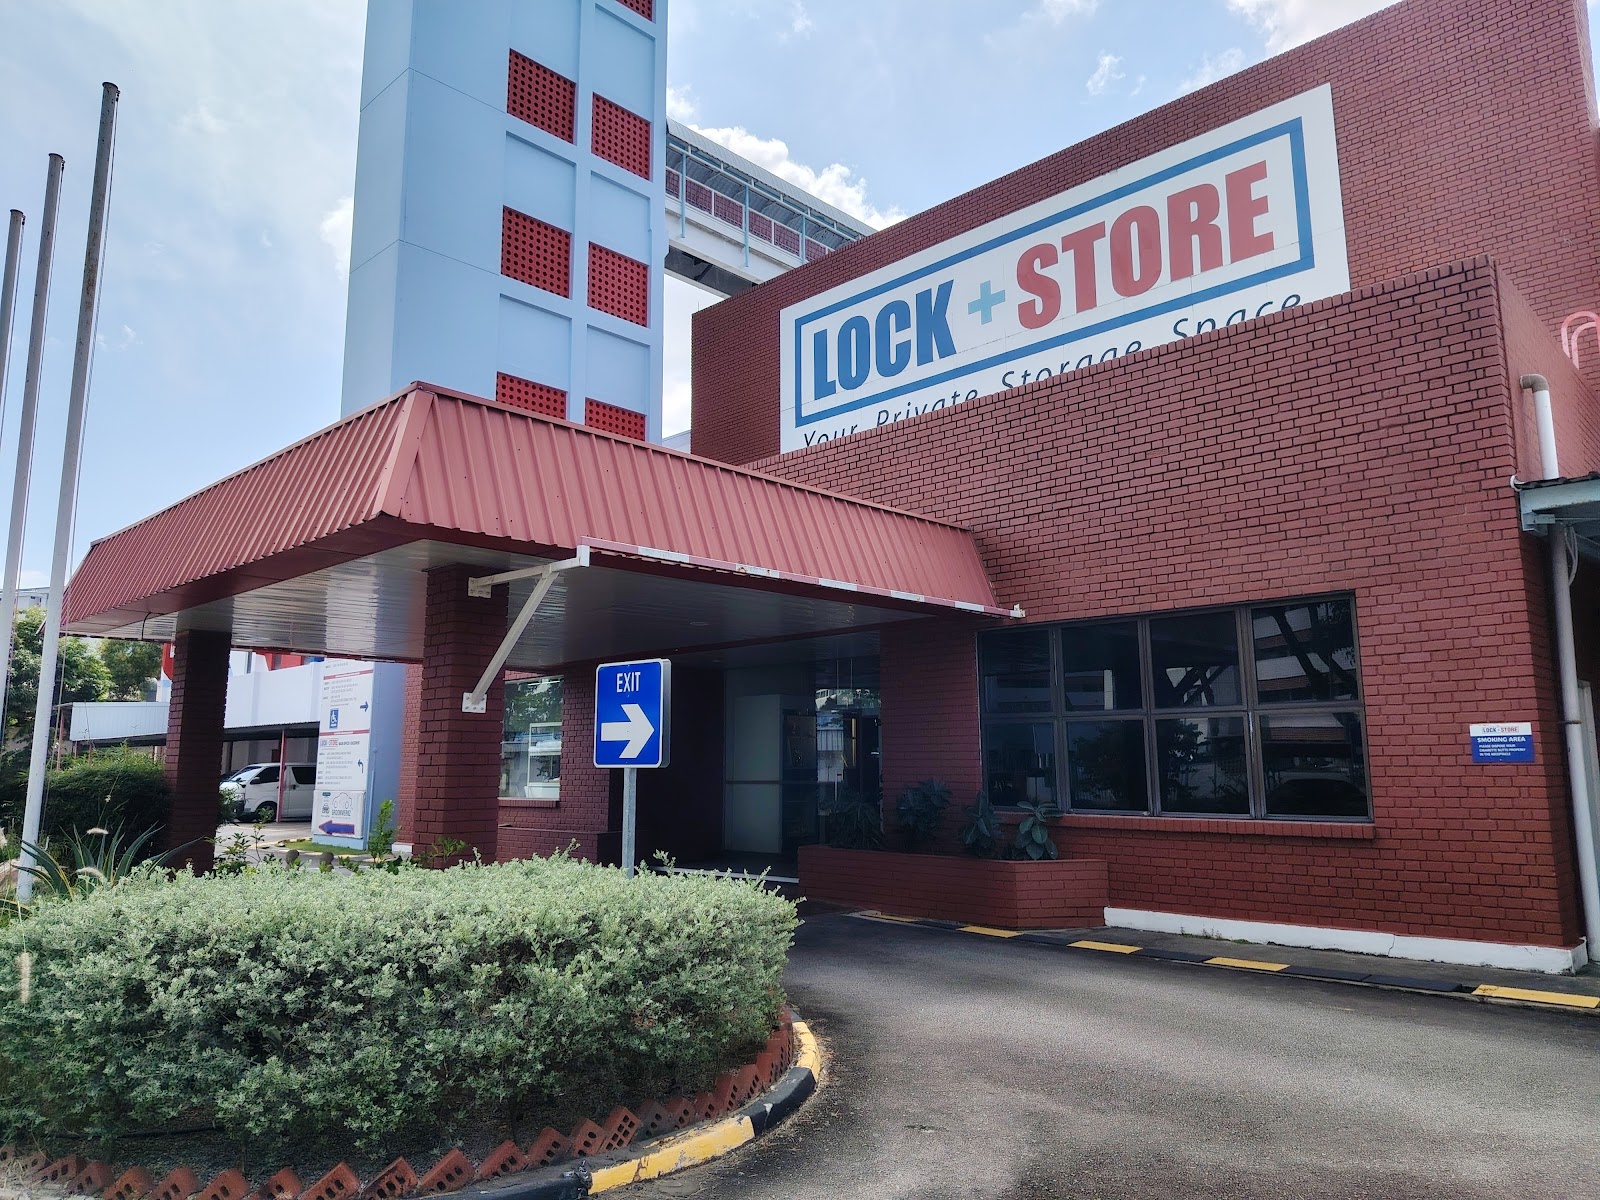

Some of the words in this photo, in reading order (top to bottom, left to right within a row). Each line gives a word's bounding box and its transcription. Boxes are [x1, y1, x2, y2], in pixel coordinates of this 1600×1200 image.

[813, 279, 957, 401] LOCK
[1016, 160, 1275, 330] STORE
[616, 671, 641, 693] EXIT
